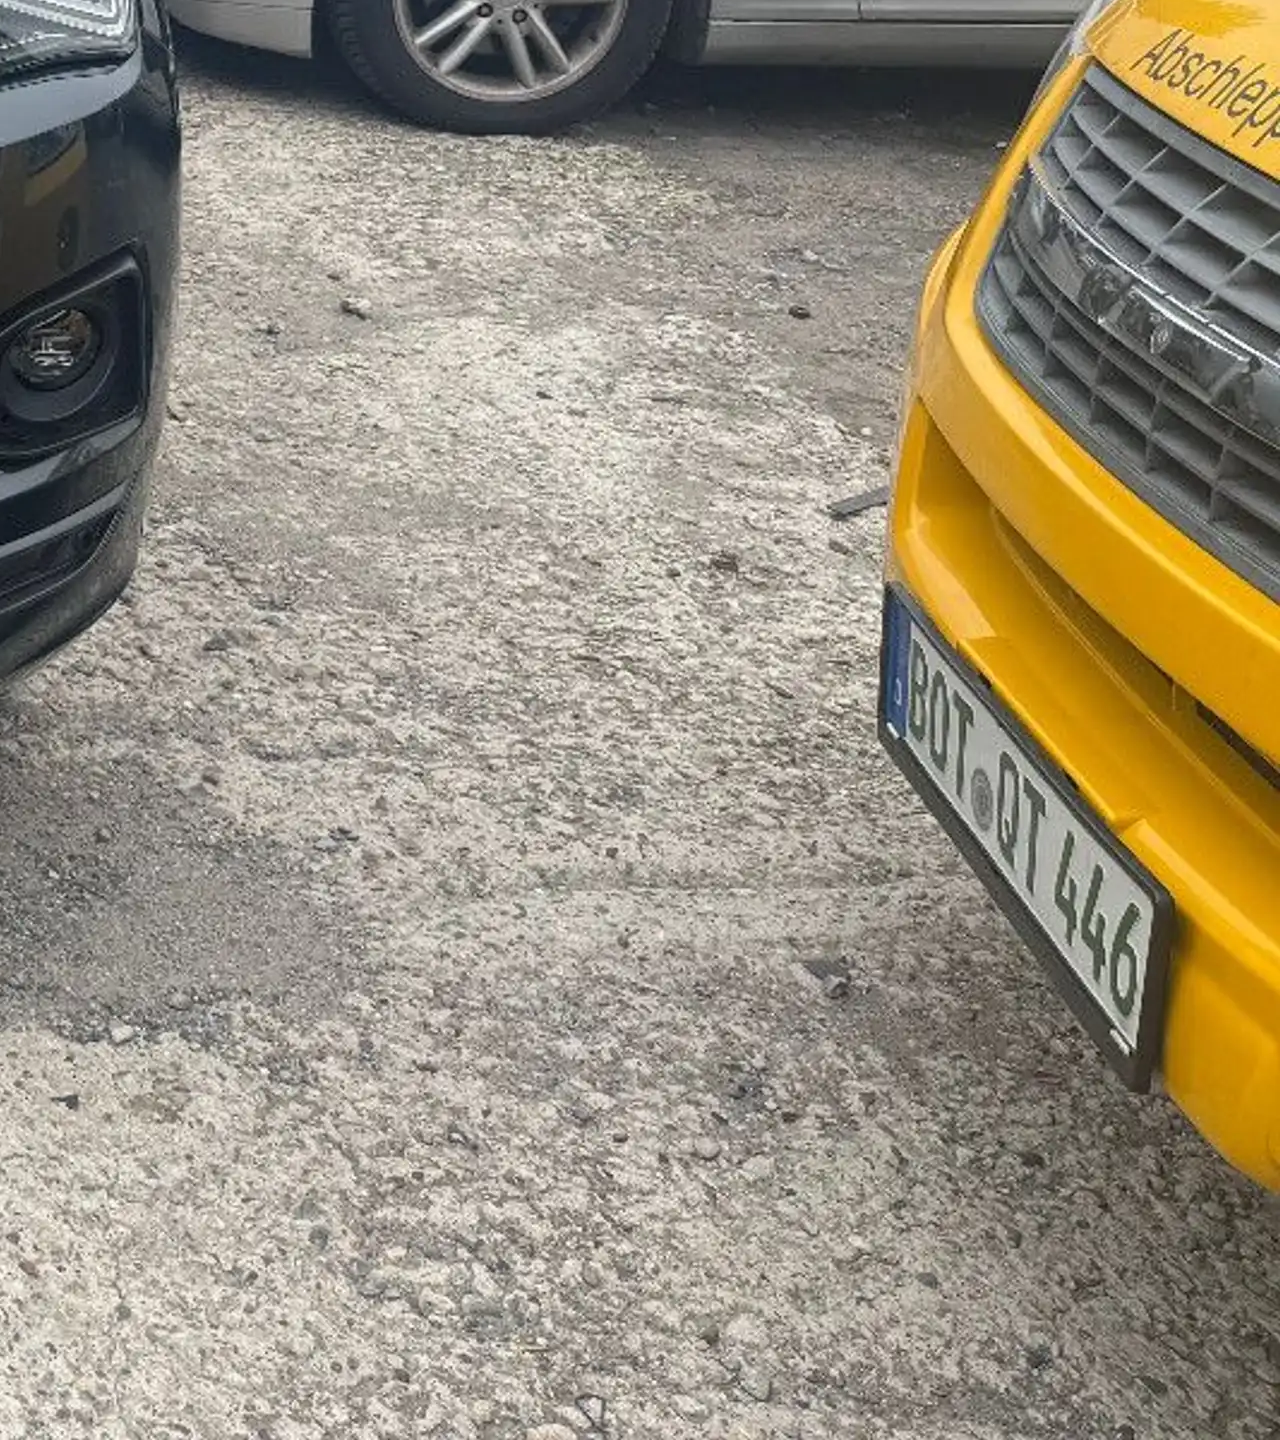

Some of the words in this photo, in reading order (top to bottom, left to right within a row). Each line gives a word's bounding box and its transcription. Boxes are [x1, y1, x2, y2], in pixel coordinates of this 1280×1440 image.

[907, 637, 974, 800] BOT
[996, 750, 1046, 896] QT
[1053, 829, 1141, 1017] 446
